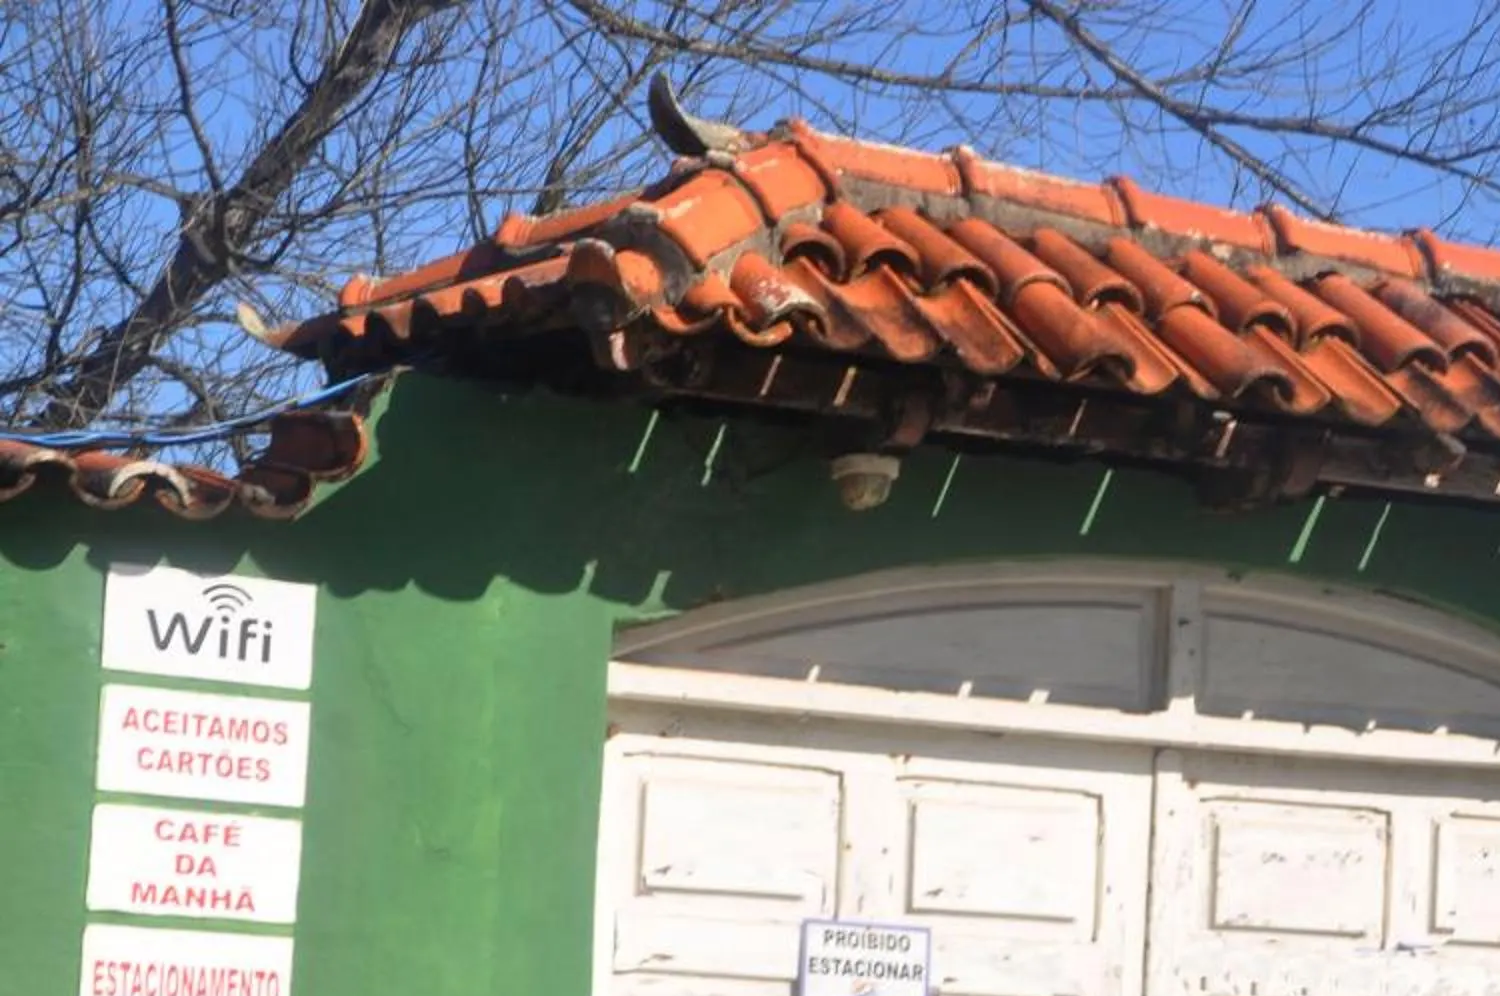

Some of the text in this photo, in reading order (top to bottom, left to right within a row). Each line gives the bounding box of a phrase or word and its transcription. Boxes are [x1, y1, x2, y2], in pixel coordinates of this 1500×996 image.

[147, 608, 273, 663] Wifi
[122, 707, 288, 746] ACEITAMOS
[174, 854, 217, 877] DA
[823, 929, 911, 952] PROIBIDO
[808, 957, 924, 981] ESTACIONAR
